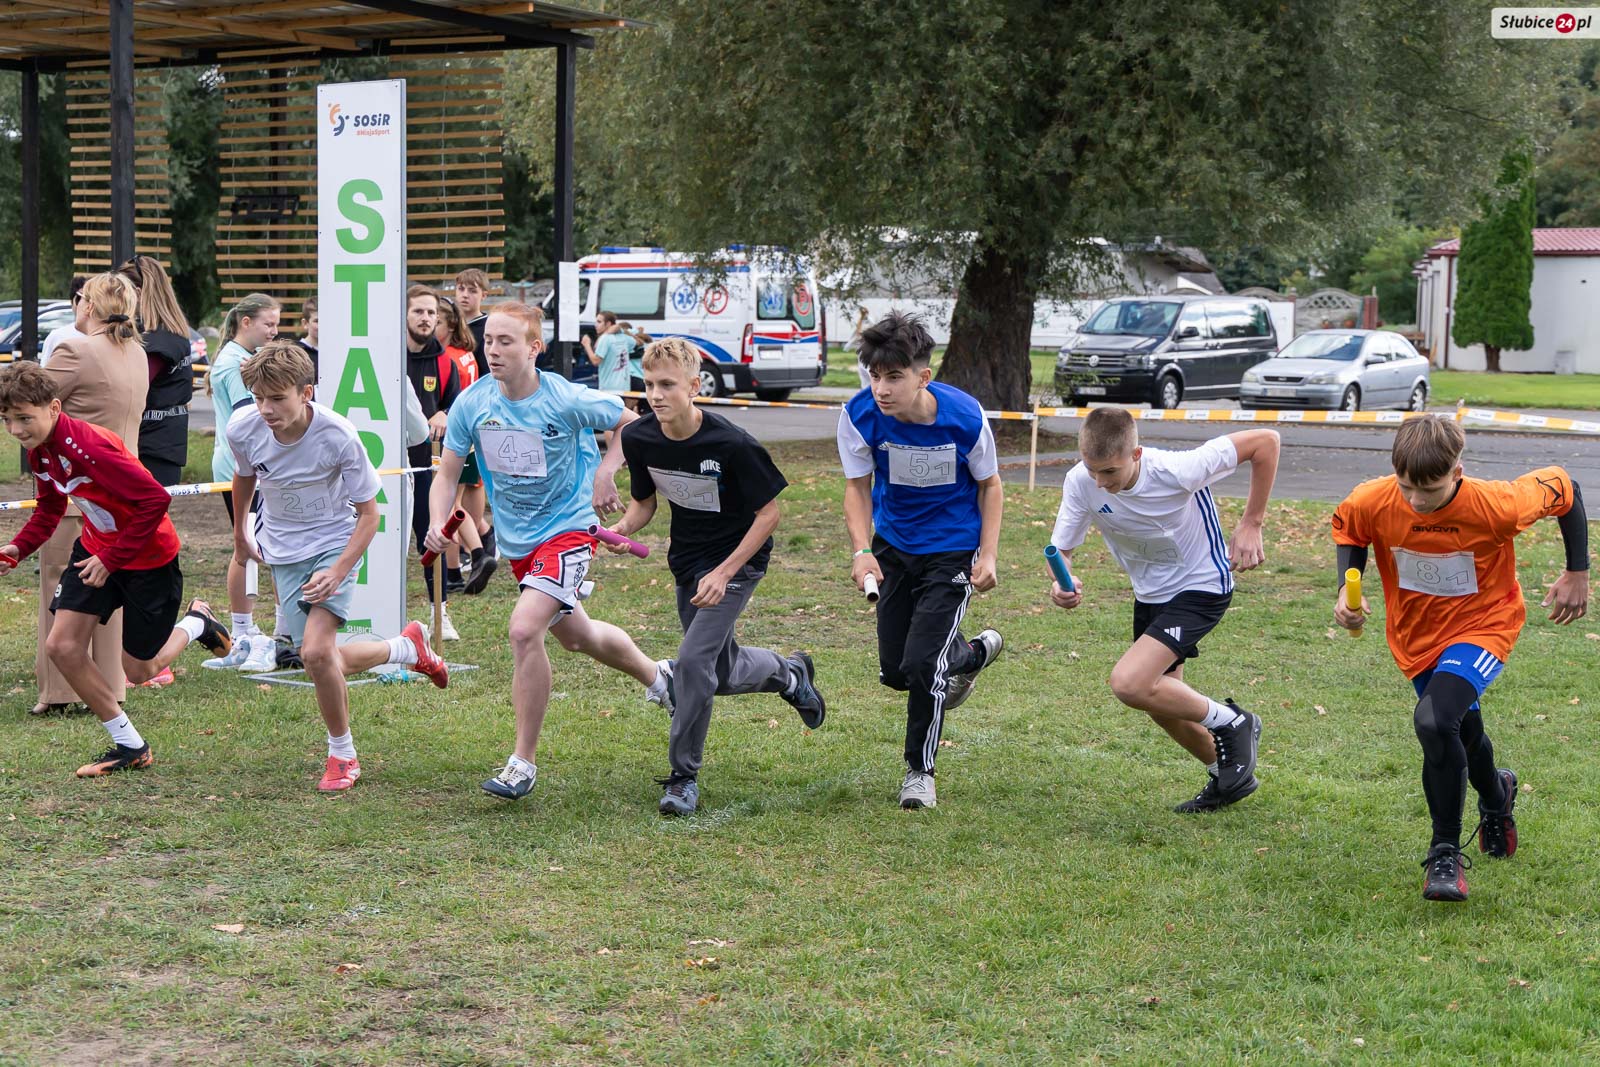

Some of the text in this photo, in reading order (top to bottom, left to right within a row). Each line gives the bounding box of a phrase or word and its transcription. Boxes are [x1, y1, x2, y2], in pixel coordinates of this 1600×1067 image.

[353, 113, 391, 127] SOSiR
[700, 459, 721, 473] NIKE
[1412, 525, 1459, 533] GIVOVA
